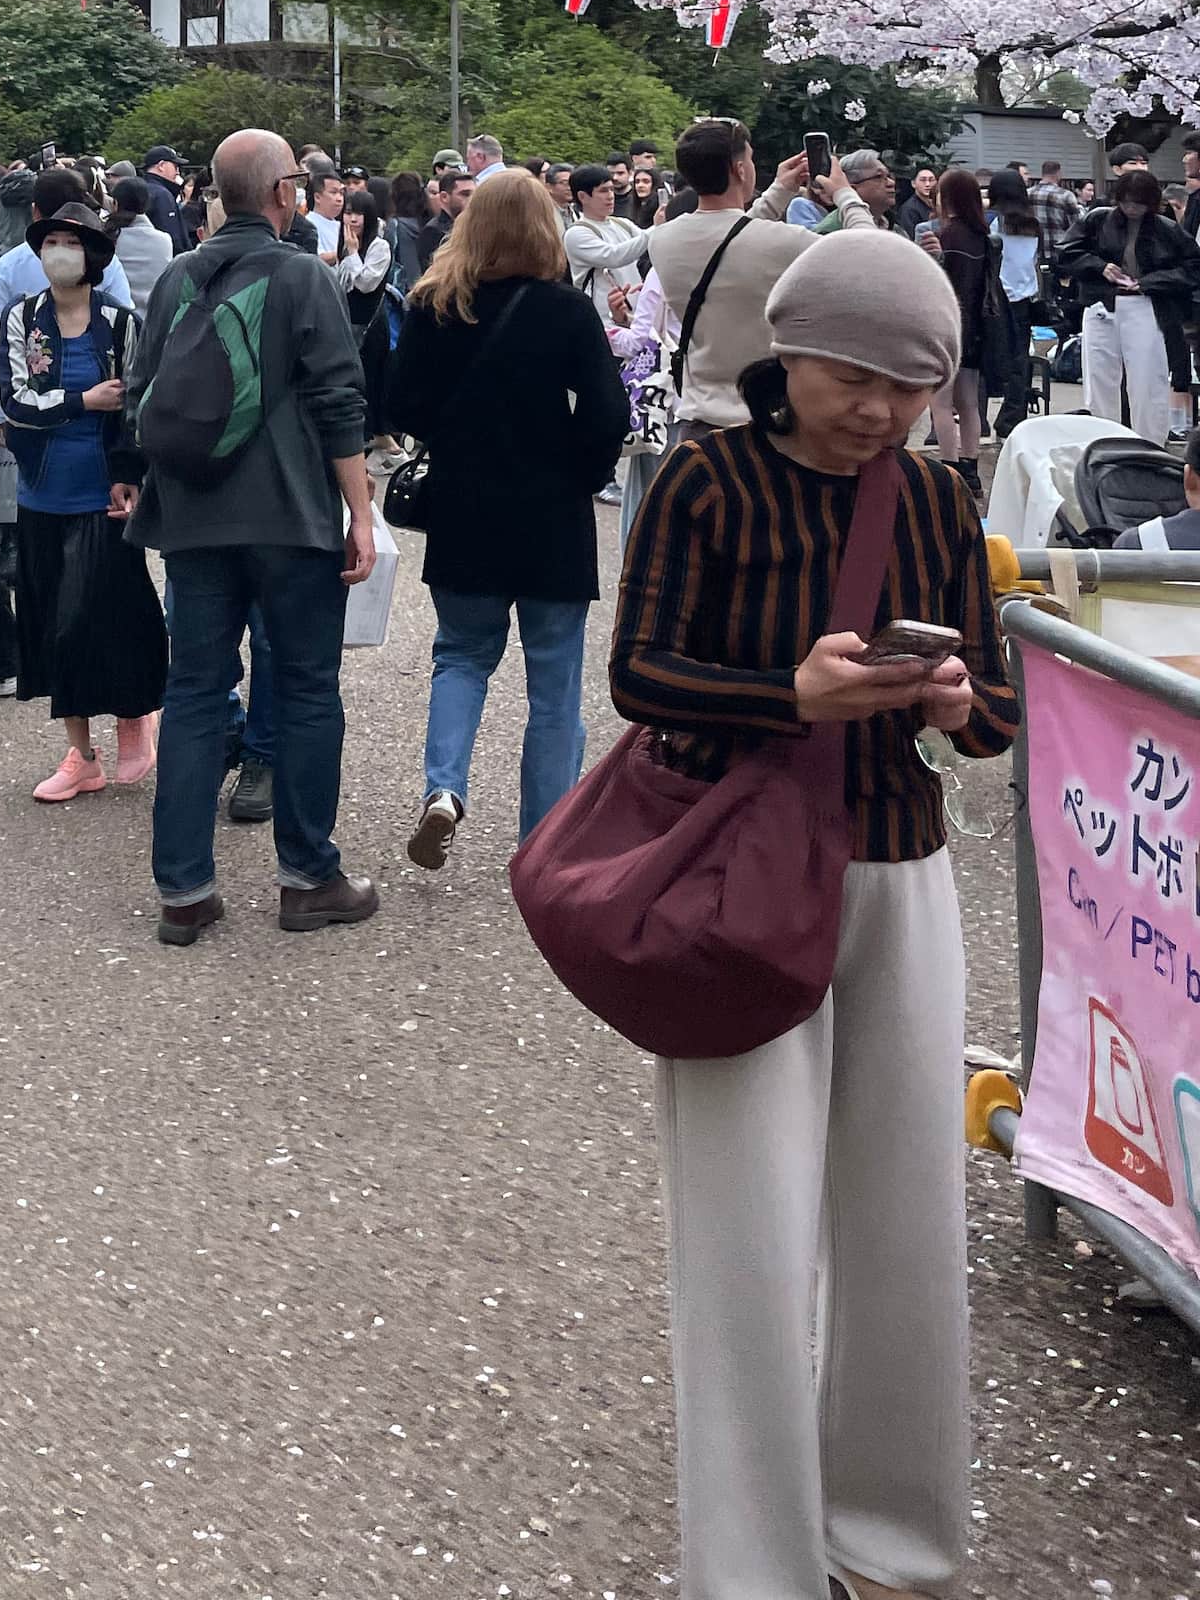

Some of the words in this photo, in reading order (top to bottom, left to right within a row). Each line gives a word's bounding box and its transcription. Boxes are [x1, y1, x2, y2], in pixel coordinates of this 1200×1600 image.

[1131, 738, 1190, 811] カン
[1063, 788, 1200, 917] ペットボ
[1131, 915, 1177, 985] PET
[1121, 1146, 1145, 1174] カン
